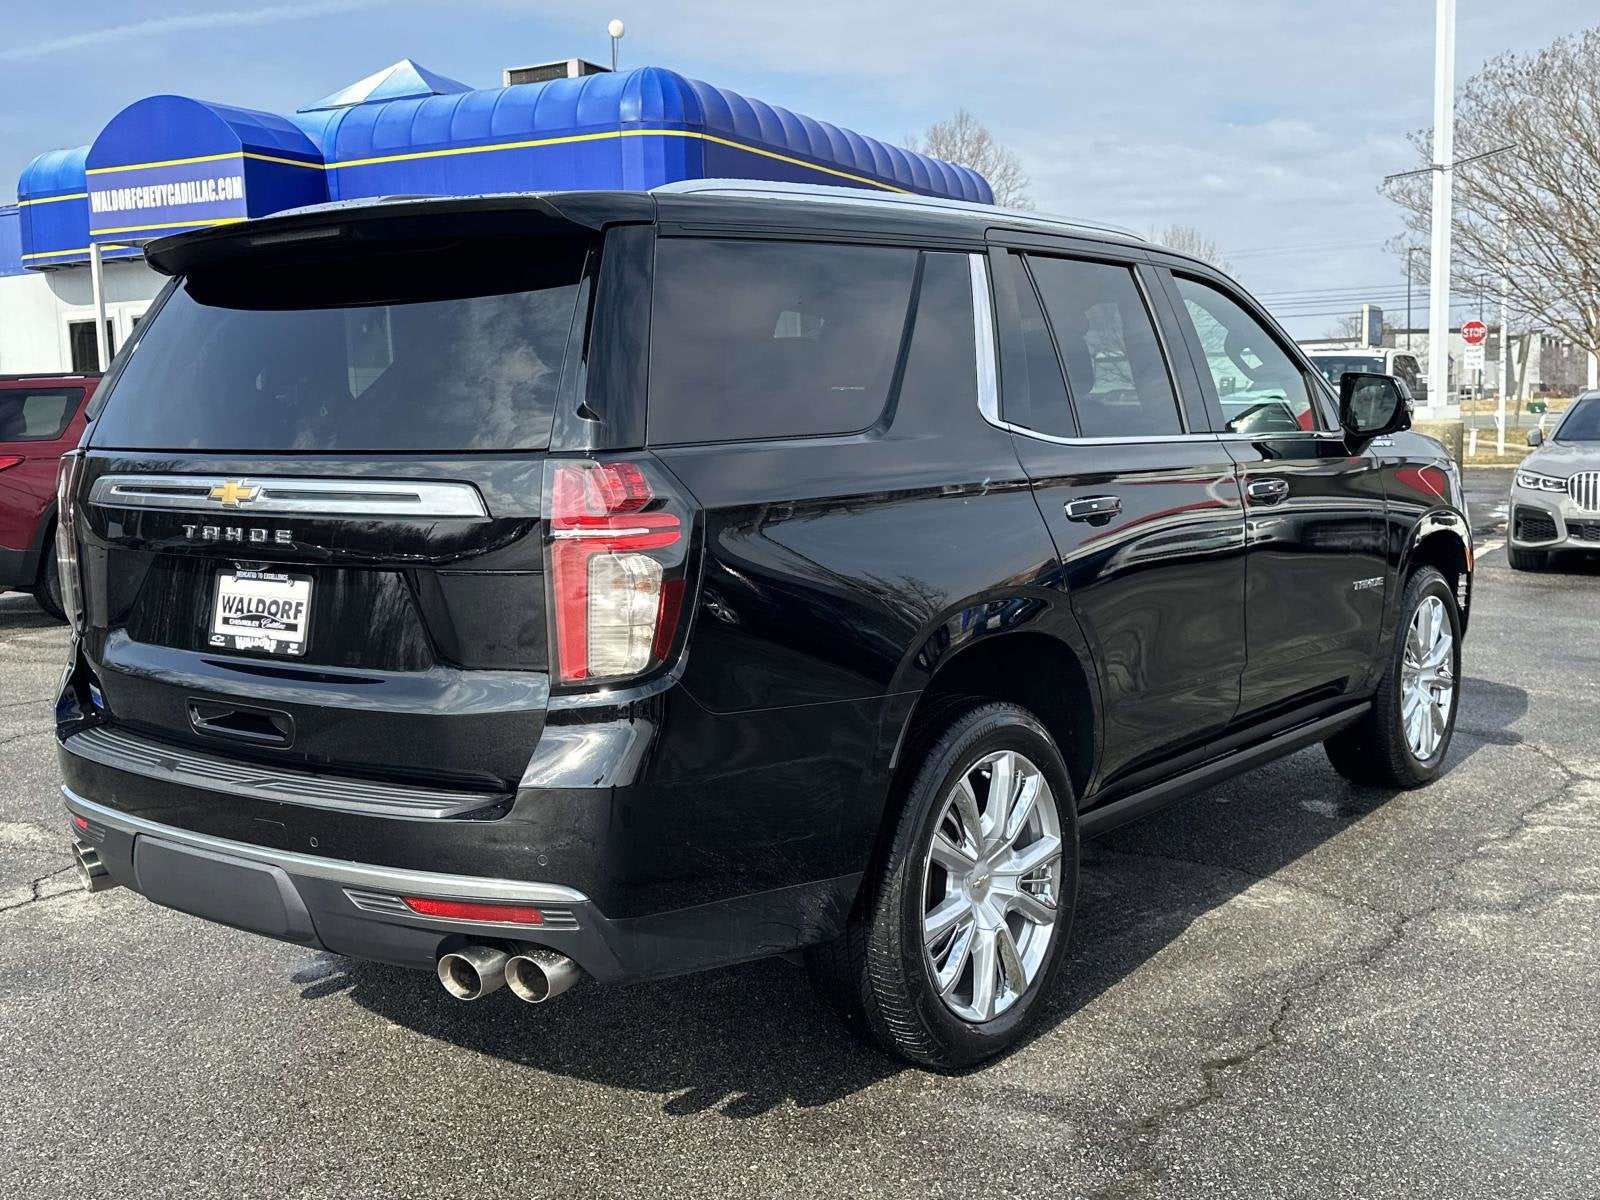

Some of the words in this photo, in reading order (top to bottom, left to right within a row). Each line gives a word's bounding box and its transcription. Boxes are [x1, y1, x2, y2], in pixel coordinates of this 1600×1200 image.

[90, 176, 243, 213] WALDORFCHEVYCADILLAC.COM
[1463, 327, 1486, 338] STOP
[182, 524, 292, 544] TAHOE
[1353, 576, 1384, 591] TAHOE
[222, 595, 304, 621] WALDORF
